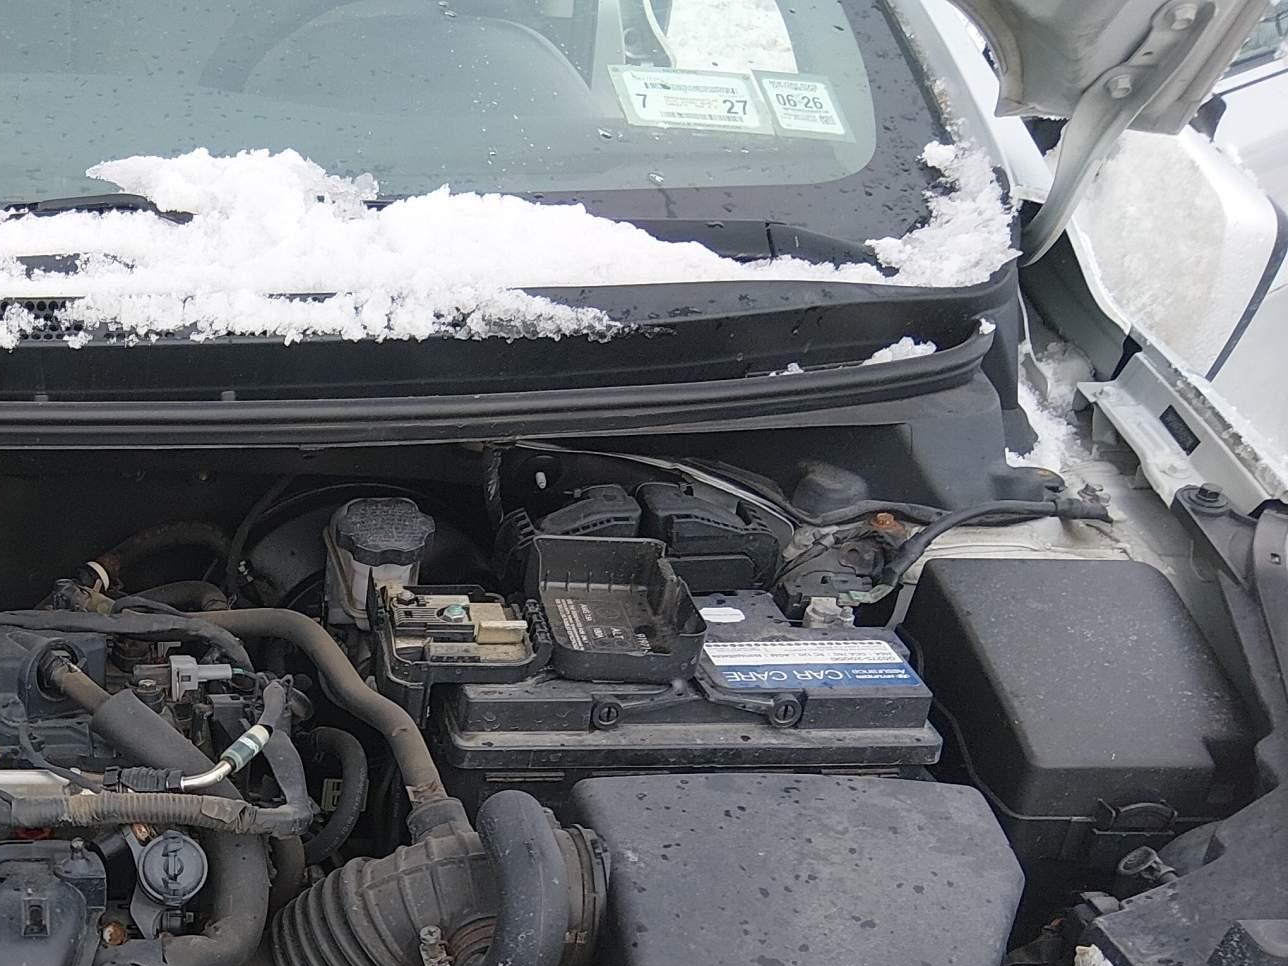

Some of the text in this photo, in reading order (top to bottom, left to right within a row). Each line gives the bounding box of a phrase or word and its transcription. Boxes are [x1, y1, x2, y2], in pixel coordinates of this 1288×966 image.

[635, 93, 648, 109] 7
[722, 99, 748, 116] 27
[722, 669, 844, 682] CAR CARE
